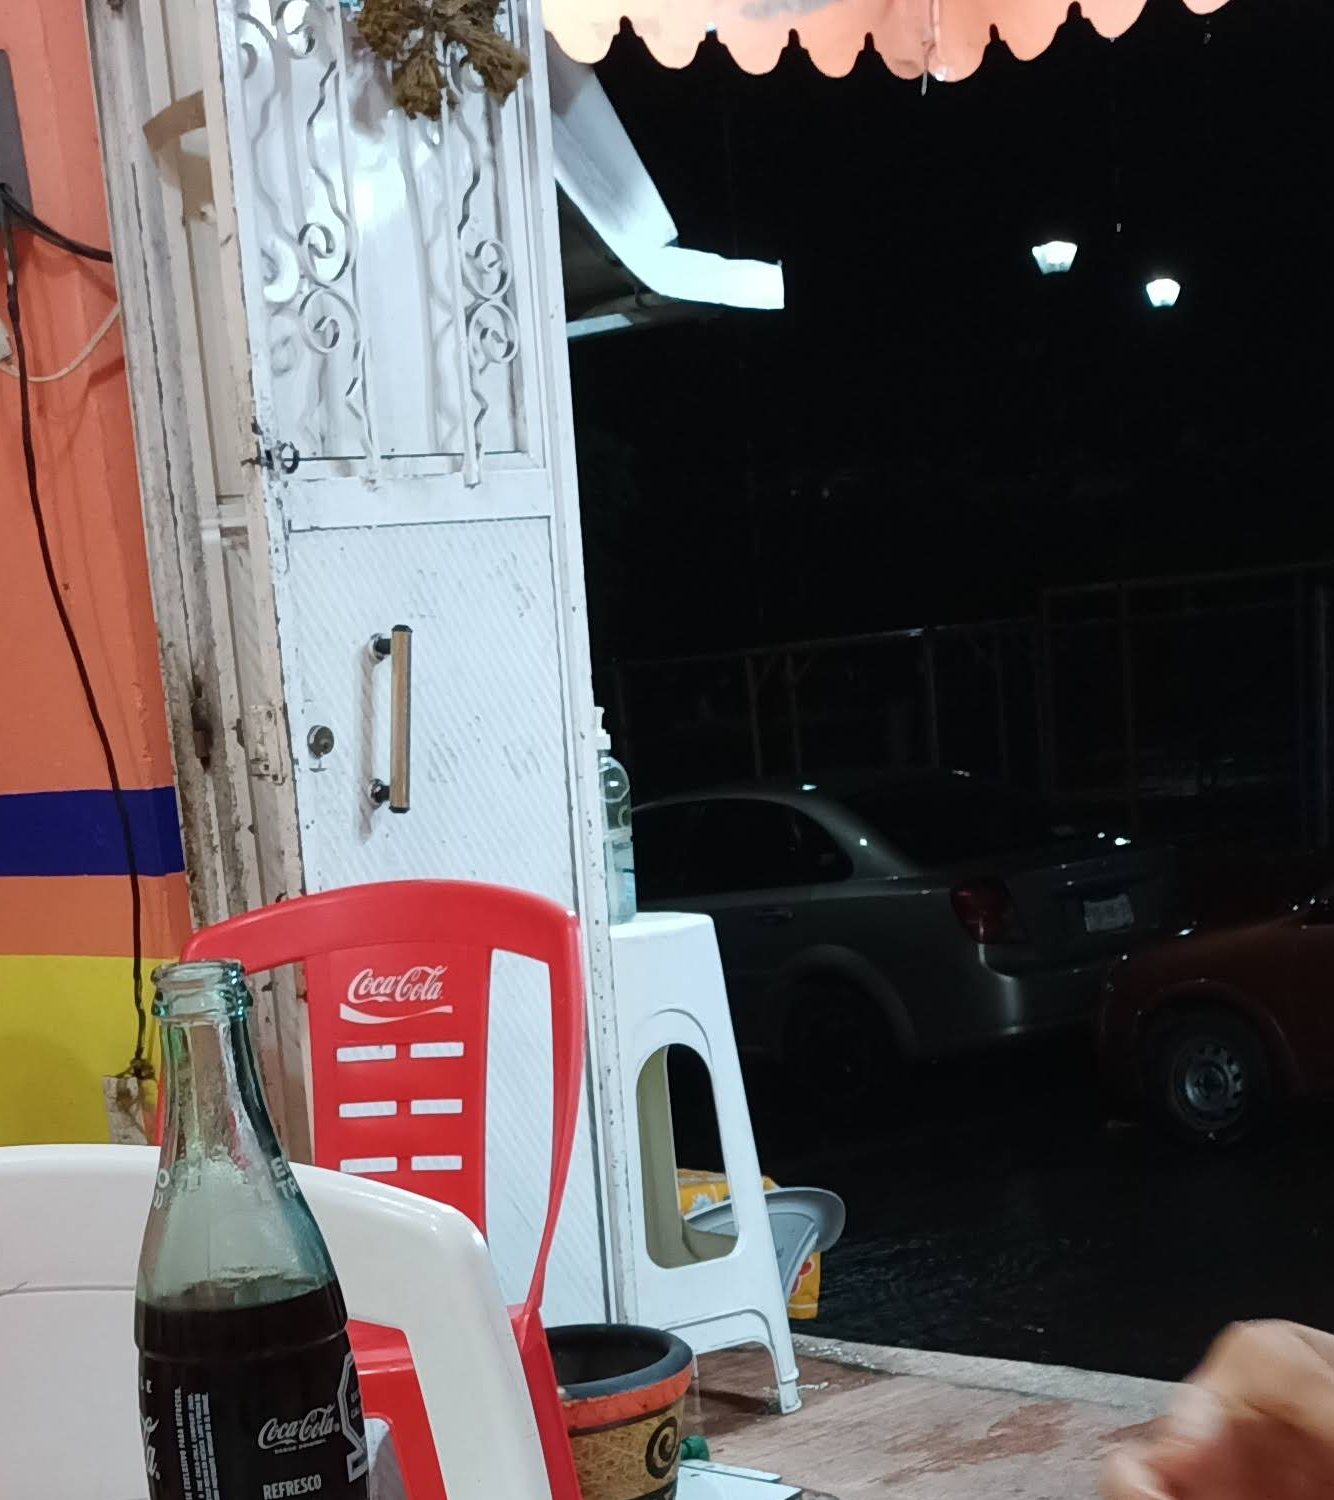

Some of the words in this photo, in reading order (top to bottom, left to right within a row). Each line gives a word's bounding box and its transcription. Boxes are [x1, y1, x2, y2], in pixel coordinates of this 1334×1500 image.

[347, 965, 448, 1004] Coca-Cola
[258, 1404, 336, 1450] Coca-Cola
[262, 1474, 322, 1500] REFRESCO
